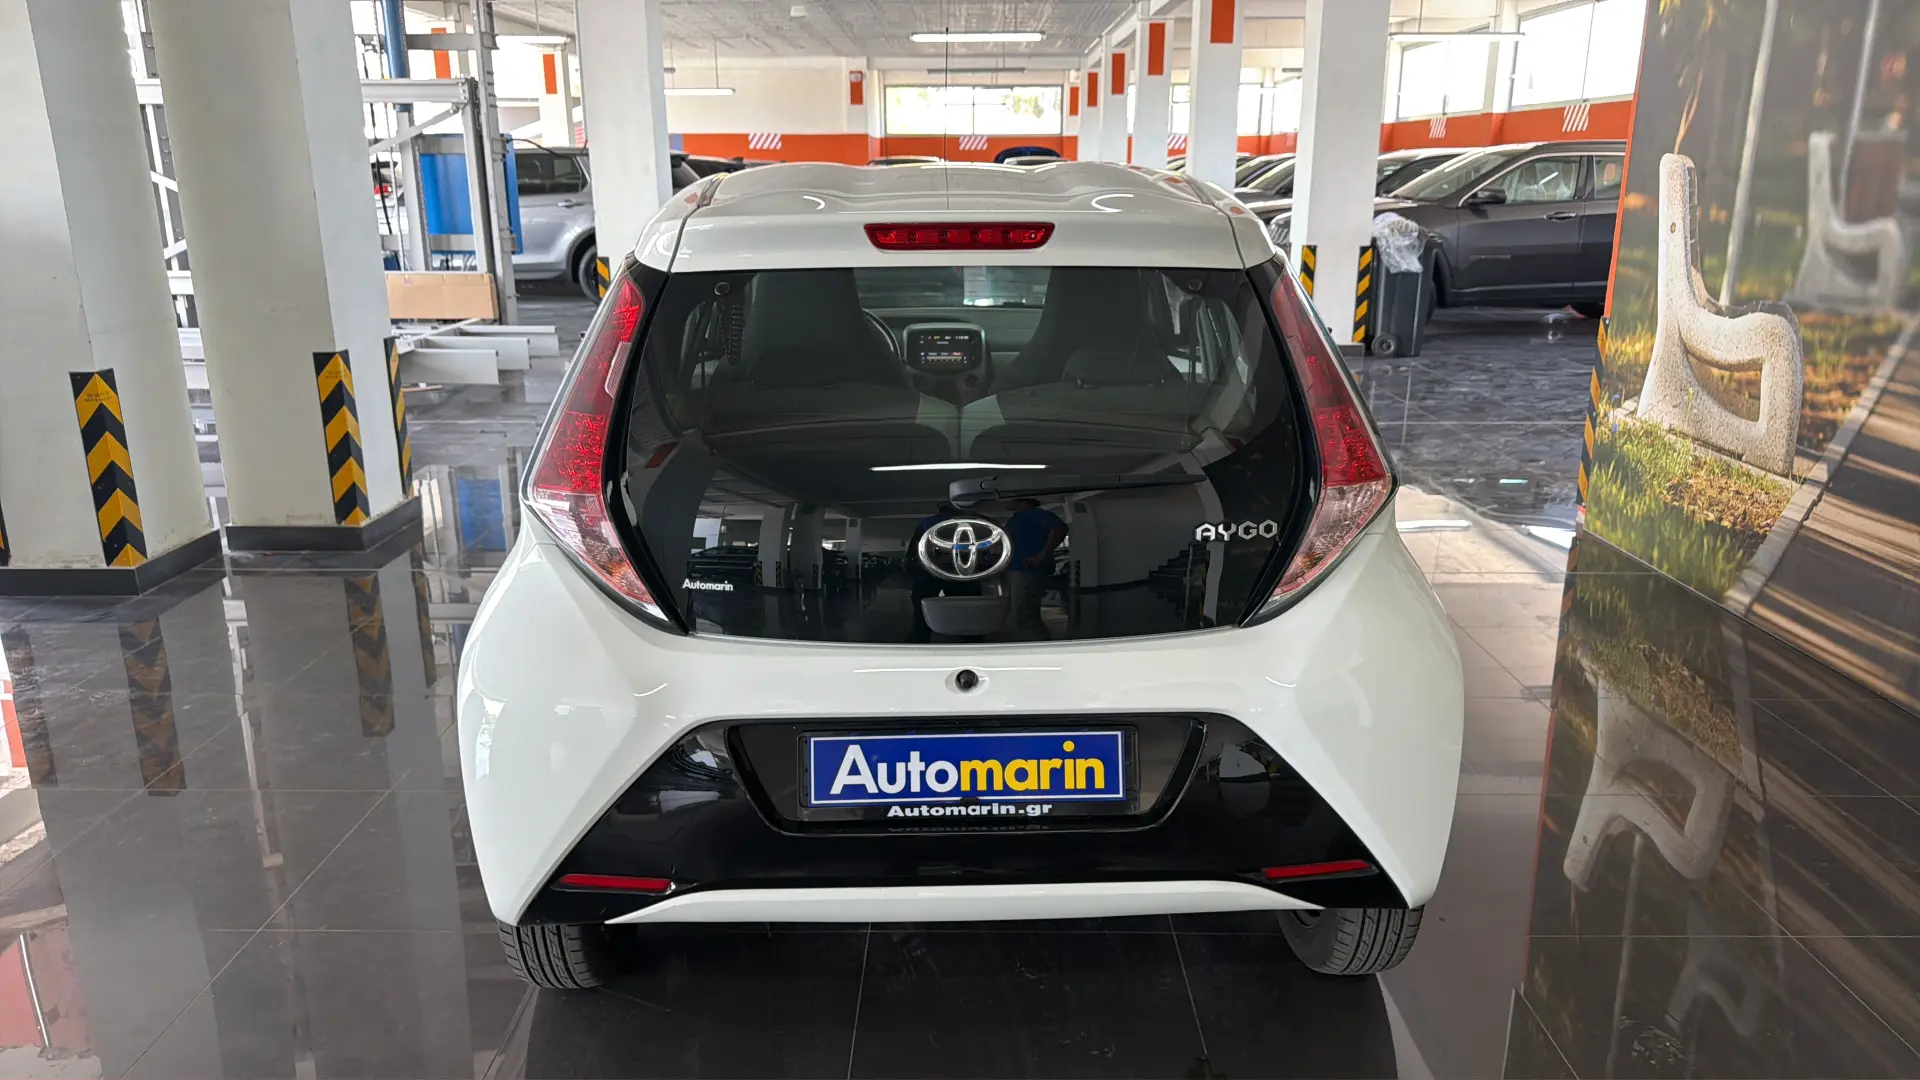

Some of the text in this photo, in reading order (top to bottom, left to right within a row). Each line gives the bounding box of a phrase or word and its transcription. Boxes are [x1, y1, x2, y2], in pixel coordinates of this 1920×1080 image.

[1195, 519, 1278, 542] AYGO
[682, 578, 734, 591] Automarin
[829, 740, 1105, 795] Automarin
[887, 803, 1053, 816] Automarin.gr
